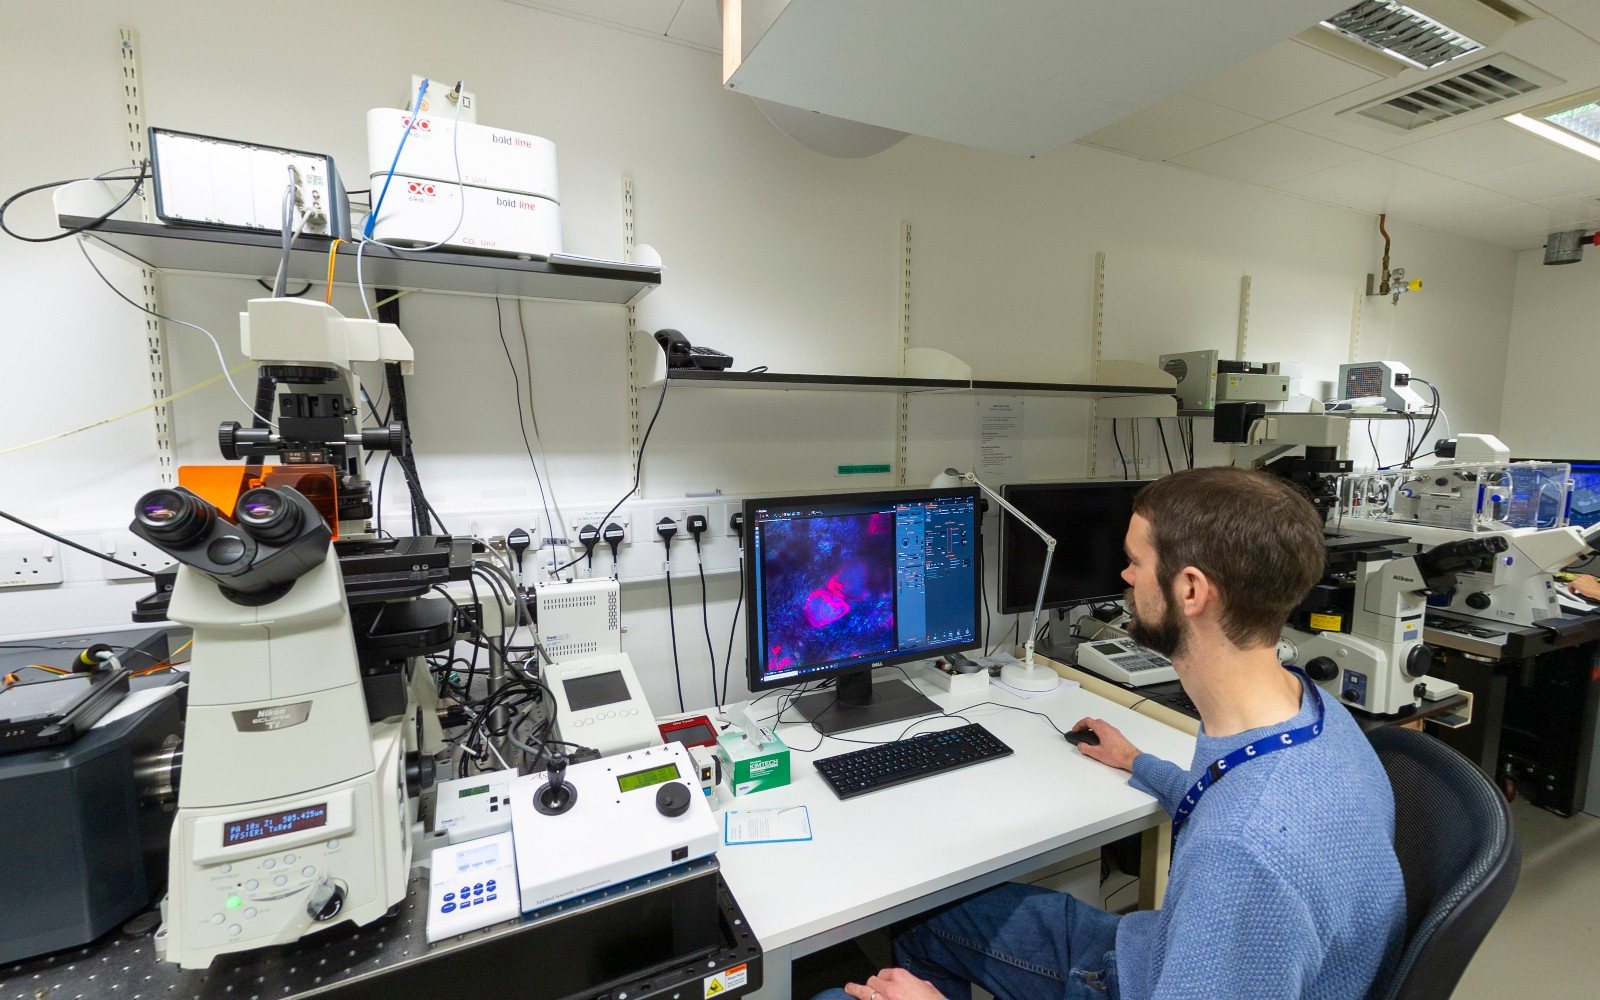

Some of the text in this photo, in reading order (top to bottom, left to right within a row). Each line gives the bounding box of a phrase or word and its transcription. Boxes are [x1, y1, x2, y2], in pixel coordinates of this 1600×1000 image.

[492, 133, 532, 149] bold line
[496, 196, 536, 211] bold line
[480, 239, 496, 248] Unit
[1392, 574, 1415, 584] Nikon
[257, 708, 286, 718] Nikon
[268, 823, 293, 833] TxRed
